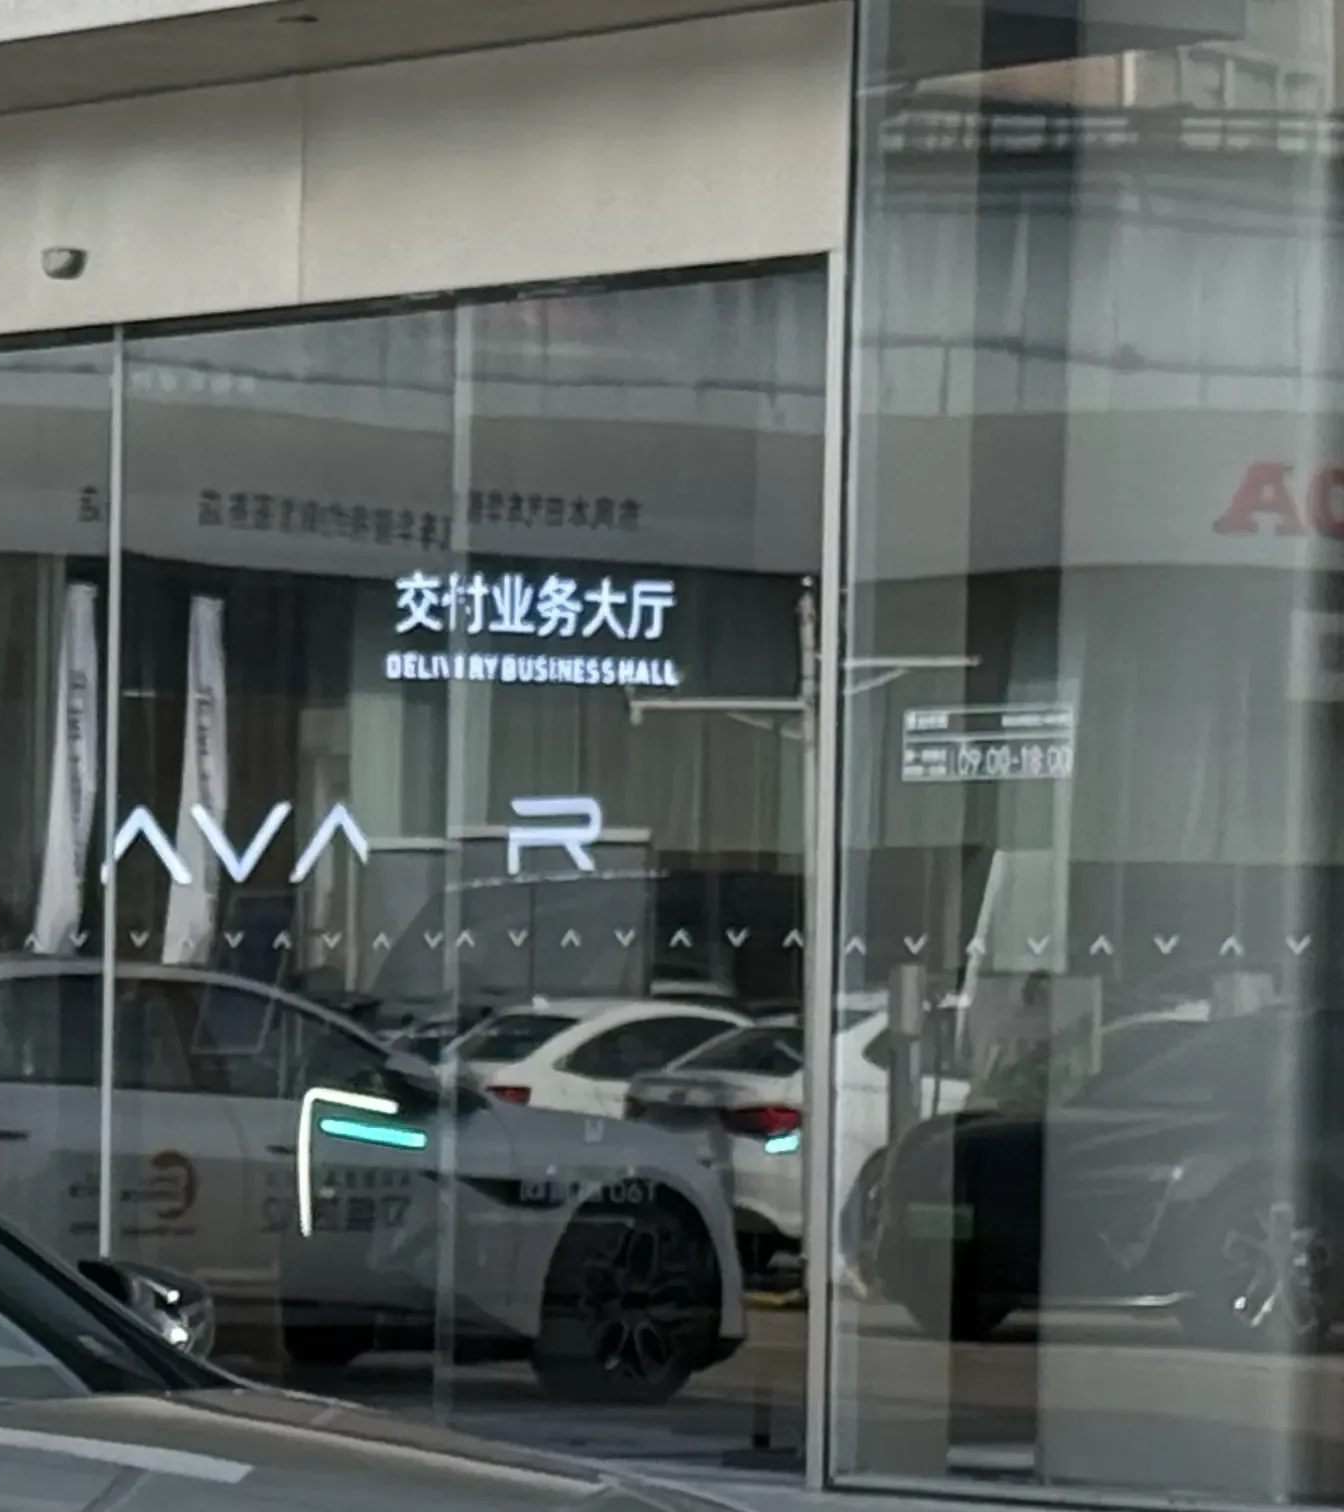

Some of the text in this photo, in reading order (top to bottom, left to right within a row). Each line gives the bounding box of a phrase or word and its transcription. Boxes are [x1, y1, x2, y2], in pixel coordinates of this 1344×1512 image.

[395, 570, 676, 640] 交付业务大厅
[386, 650, 500, 681] DELIVRY
